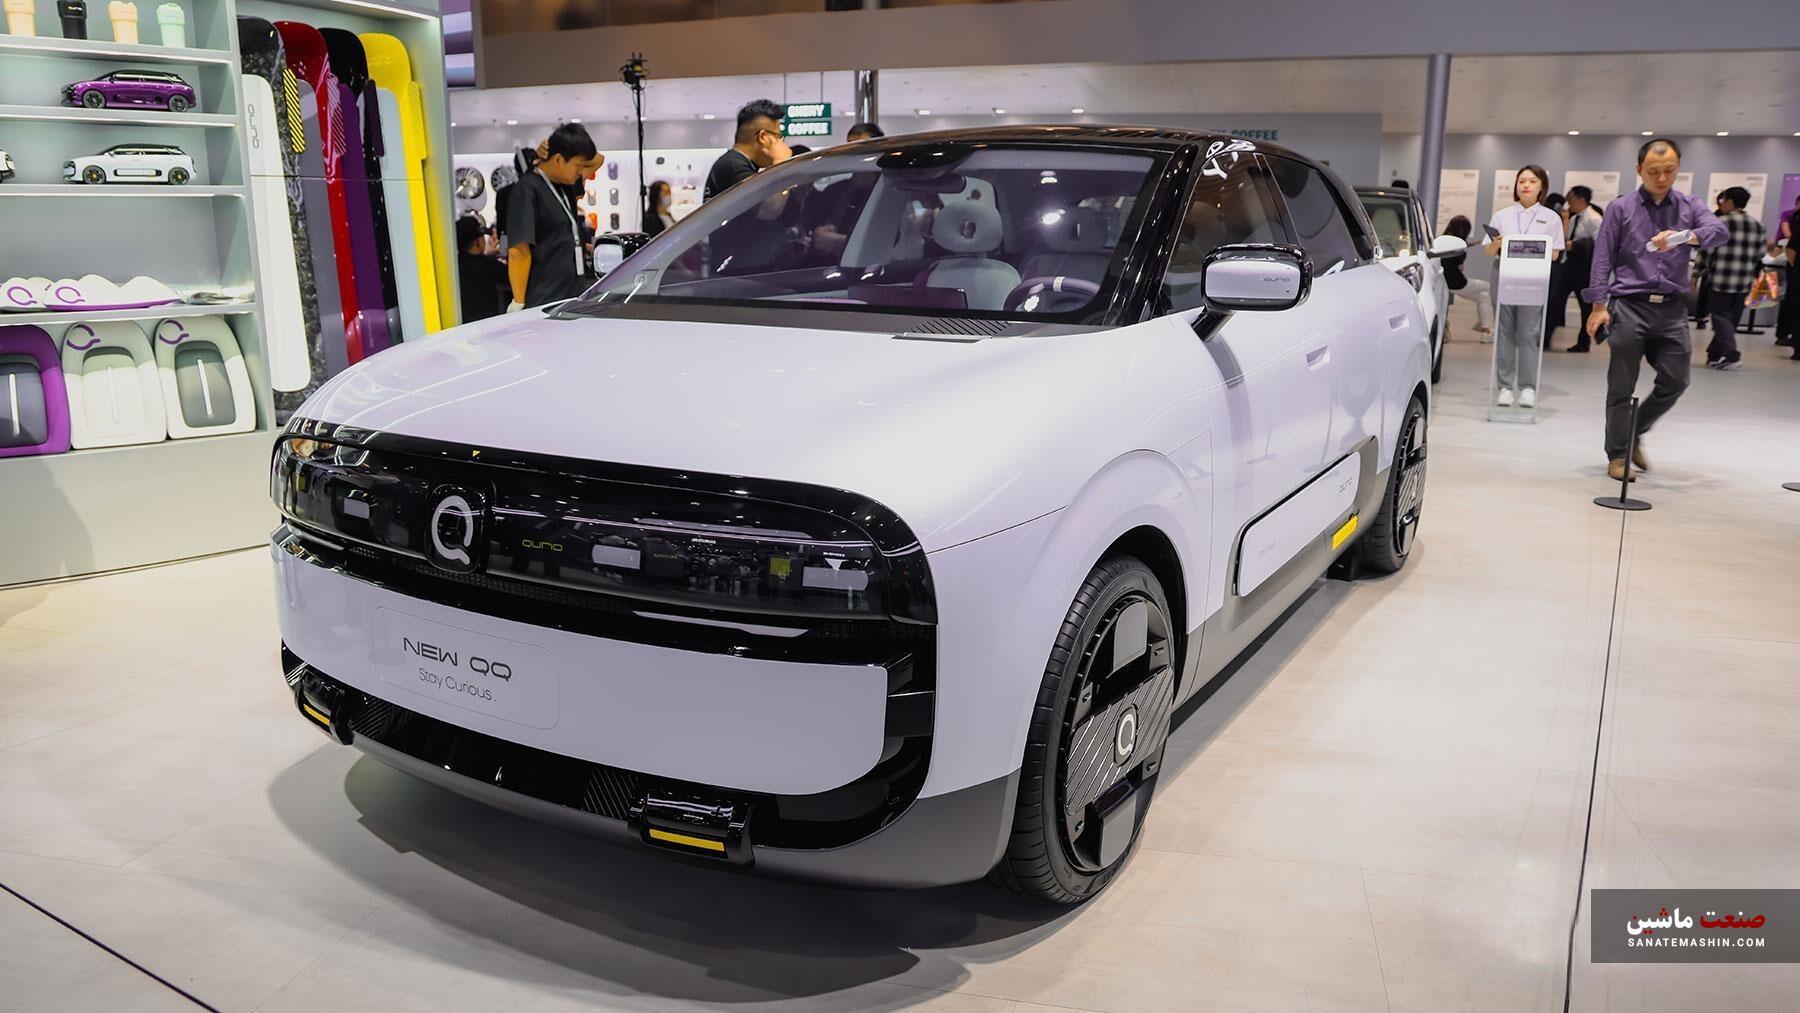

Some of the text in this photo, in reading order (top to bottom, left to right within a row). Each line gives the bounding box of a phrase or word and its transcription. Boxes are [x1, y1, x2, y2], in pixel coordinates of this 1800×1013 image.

[431, 495, 474, 566] Q
[403, 637, 512, 682] NEW QQ
[418, 667, 443, 689] Stay
